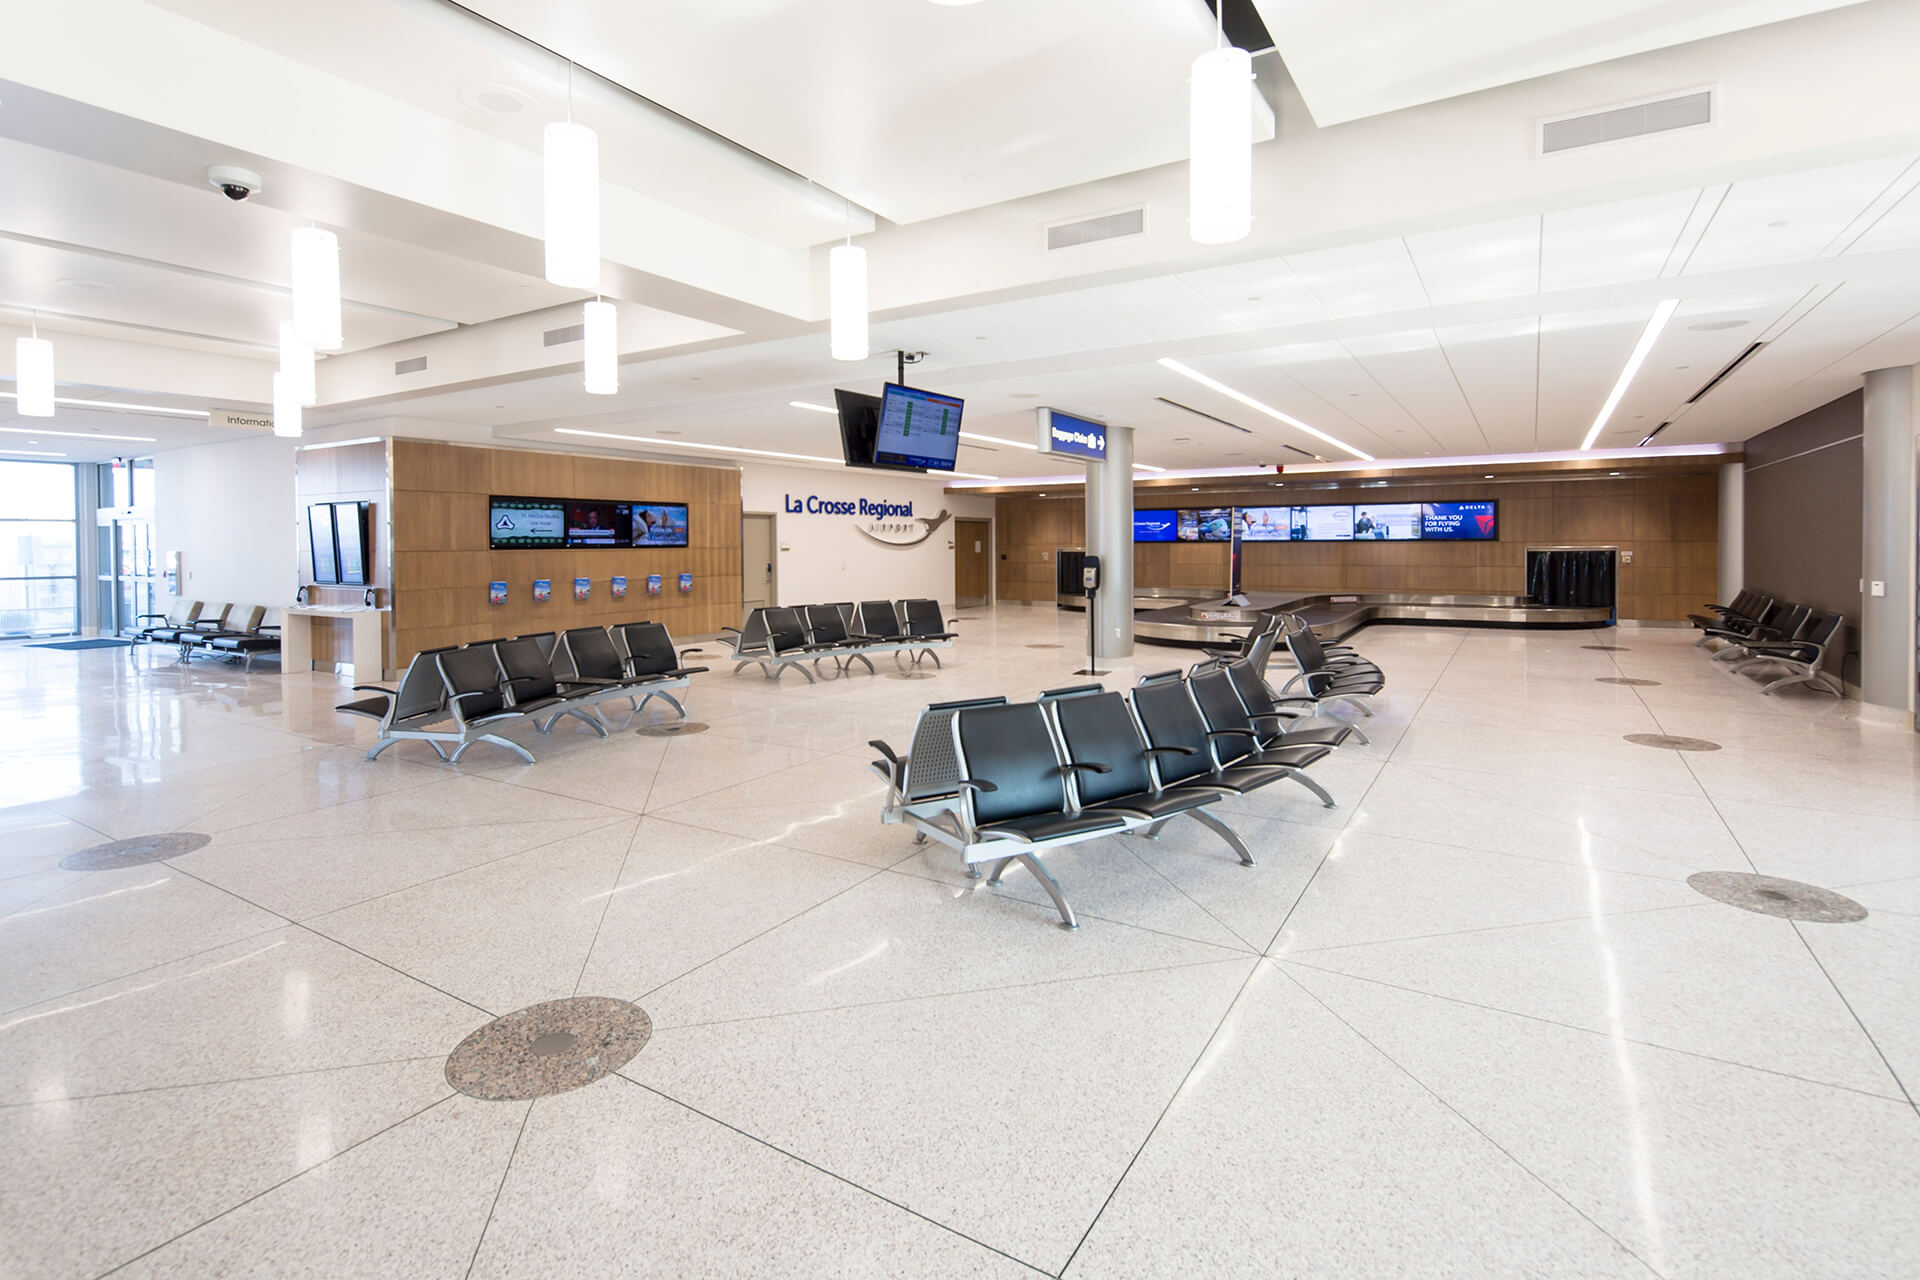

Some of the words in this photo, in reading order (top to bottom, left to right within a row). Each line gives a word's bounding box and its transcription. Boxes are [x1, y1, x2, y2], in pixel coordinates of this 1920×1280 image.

[227, 416, 274, 428] Informati
[785, 494, 803, 514] La
[807, 495, 856, 515] Crosse
[859, 499, 914, 521] Regional
[868, 524, 915, 533] AIRPORT
